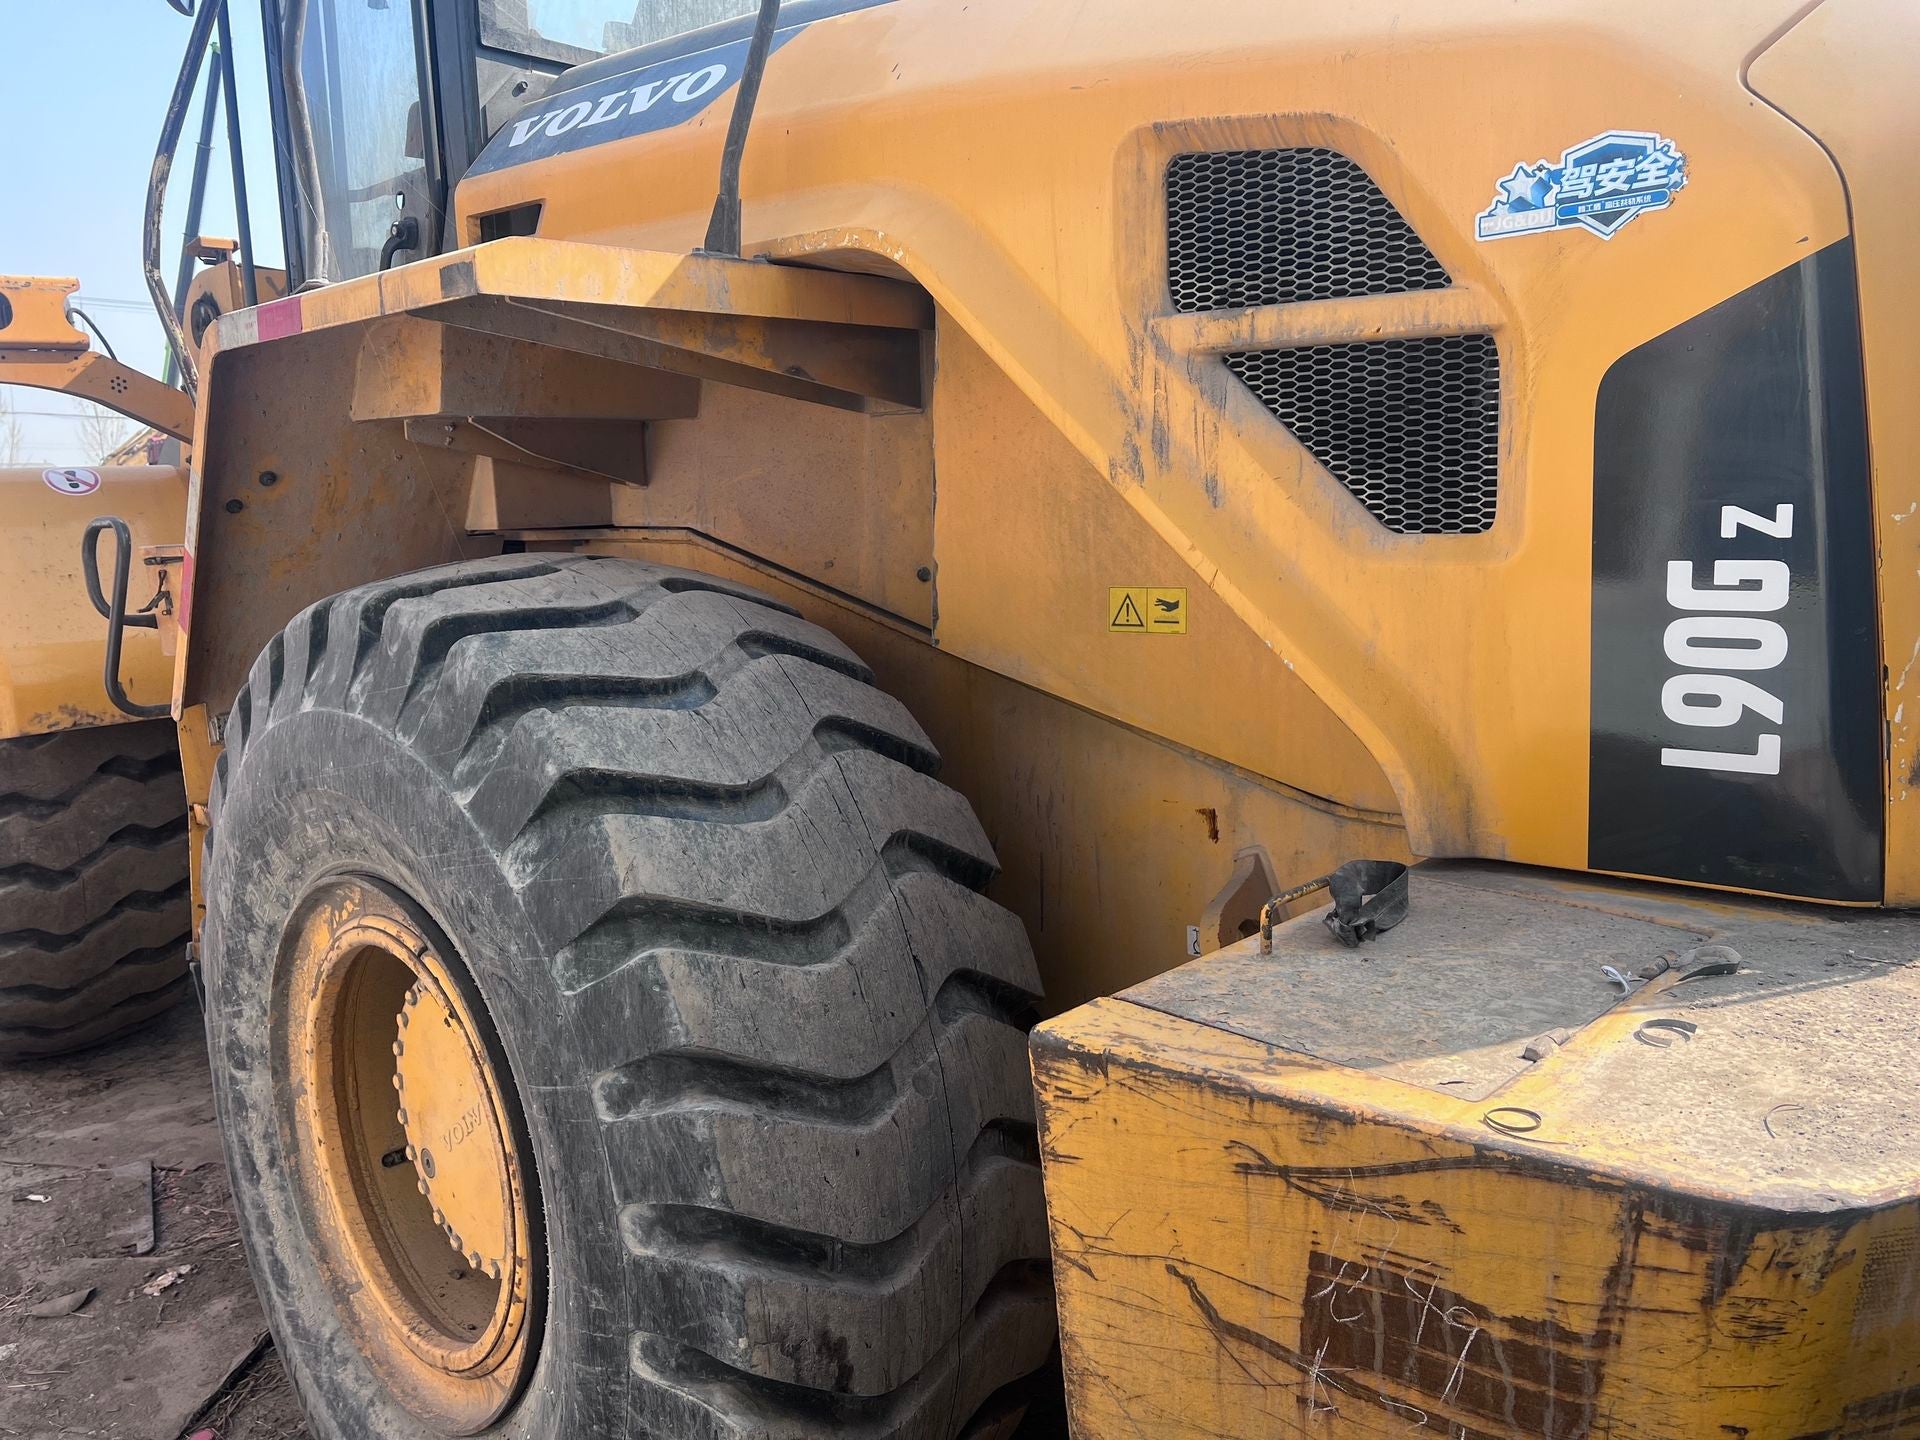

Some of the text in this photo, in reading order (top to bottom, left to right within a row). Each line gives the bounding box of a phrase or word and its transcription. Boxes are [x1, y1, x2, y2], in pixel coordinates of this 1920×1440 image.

[508, 63, 728, 148] VOLVO
[1556, 151, 1675, 199] 驾安全
